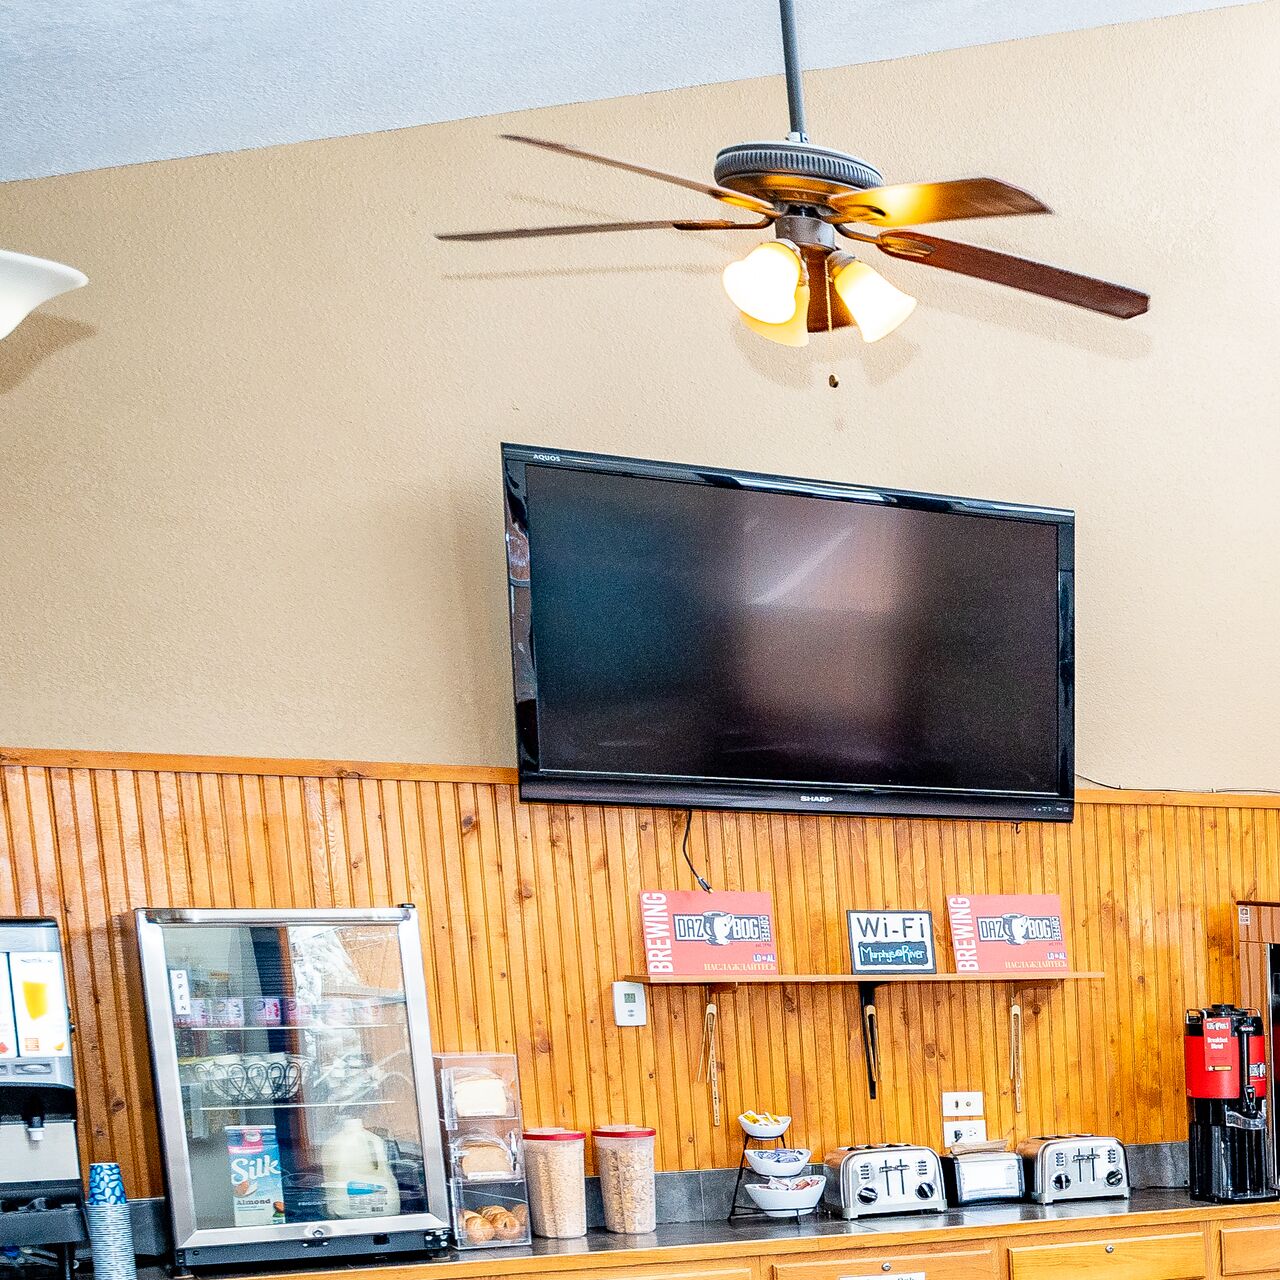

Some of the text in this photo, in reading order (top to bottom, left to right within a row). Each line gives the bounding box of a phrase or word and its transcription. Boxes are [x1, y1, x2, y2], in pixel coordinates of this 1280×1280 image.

[533, 453, 561, 462] AQUOS
[800, 795, 833, 803] SHARP
[642, 892, 674, 973] BREWING
[677, 918, 759, 939] DAZ BOG
[760, 915, 771, 942] COFFEE
[856, 917, 925, 938] Wi-Fi
[949, 897, 980, 971] BREWING
[980, 919, 1051, 939] DAZ BOG
[753, 954, 775, 963] LOAL
[231, 1154, 282, 1186] Silk
[236, 1198, 271, 1206] Almond
